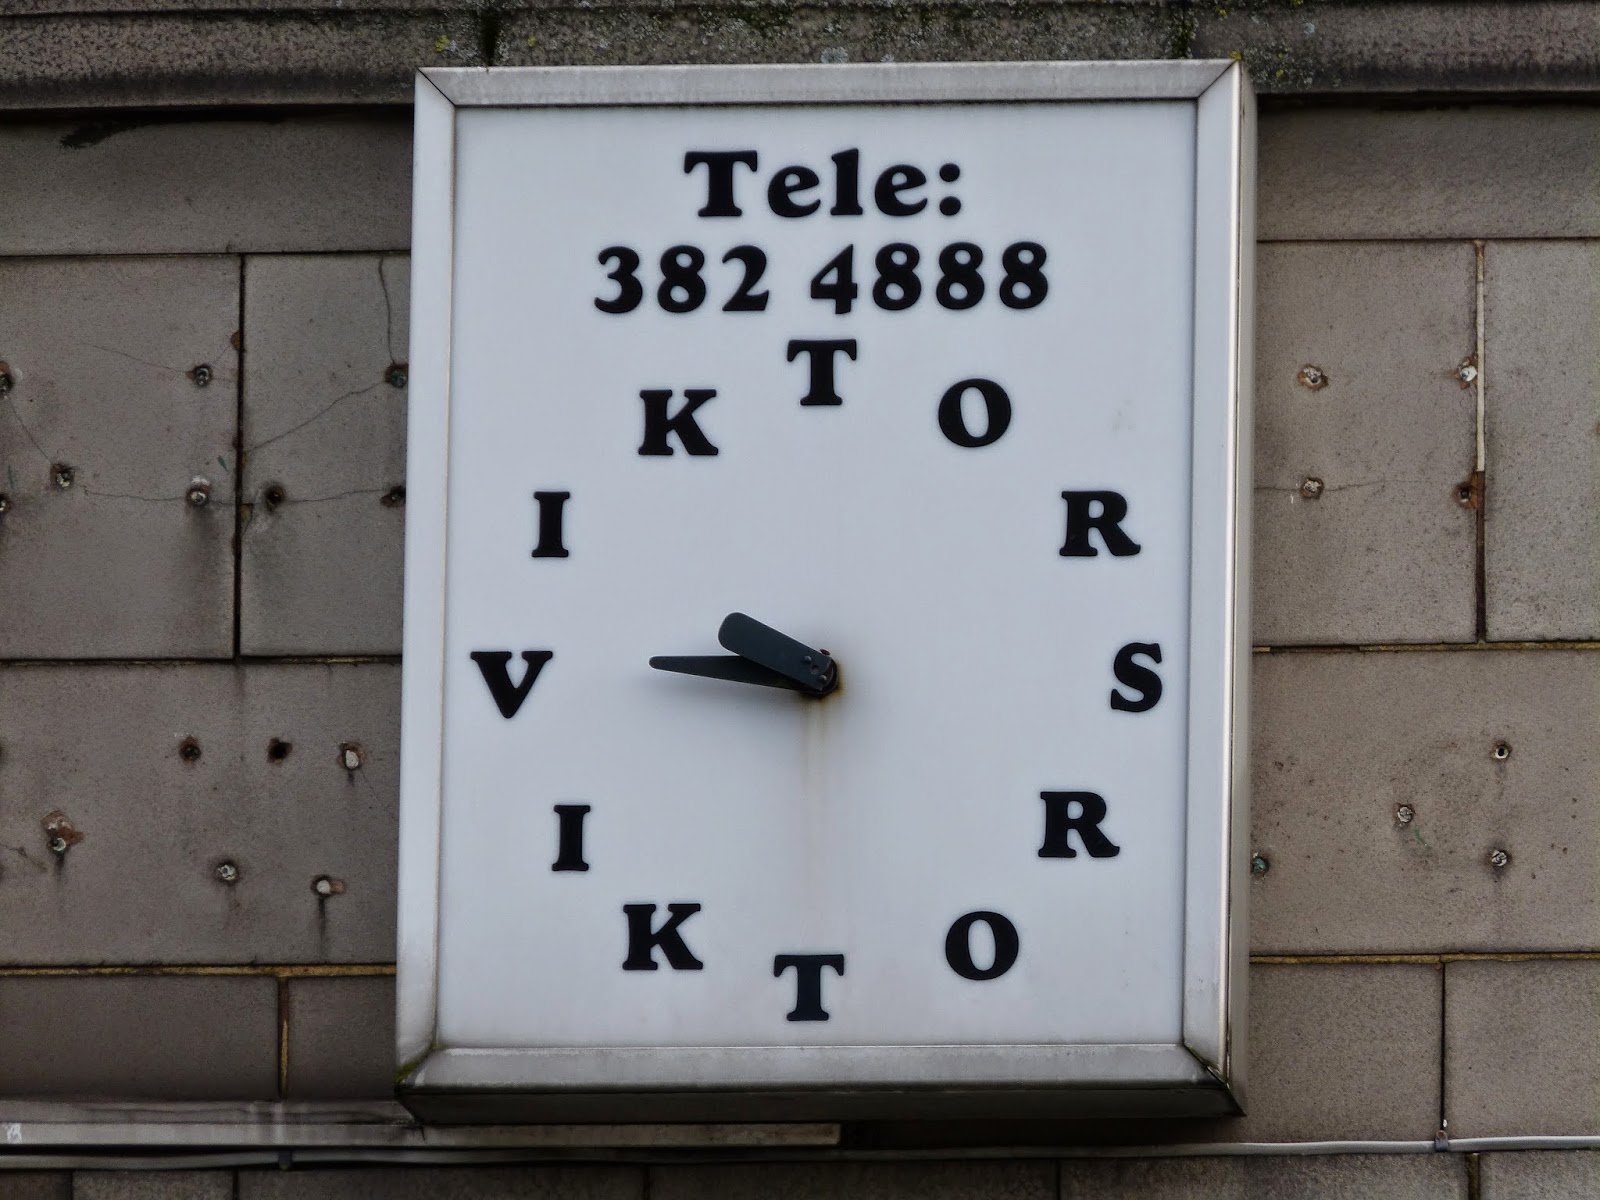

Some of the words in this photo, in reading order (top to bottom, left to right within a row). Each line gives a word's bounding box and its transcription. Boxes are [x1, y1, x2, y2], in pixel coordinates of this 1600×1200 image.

[683, 147, 962, 219] Tele:
[593, 243, 770, 315] 382
[809, 240, 1049, 316] 4888
[469, 650, 554, 720] V
[531, 490, 571, 559] I
[637, 388, 720, 457] K
[786, 338, 858, 408] T
[937, 377, 1013, 449] O
[1058, 489, 1142, 558] R
[1109, 641, 1163, 714] S
[550, 804, 592, 873] I
[621, 902, 704, 972] K
[772, 953, 846, 1023] T
[944, 910, 1020, 982] O
[1037, 790, 1121, 859] R
